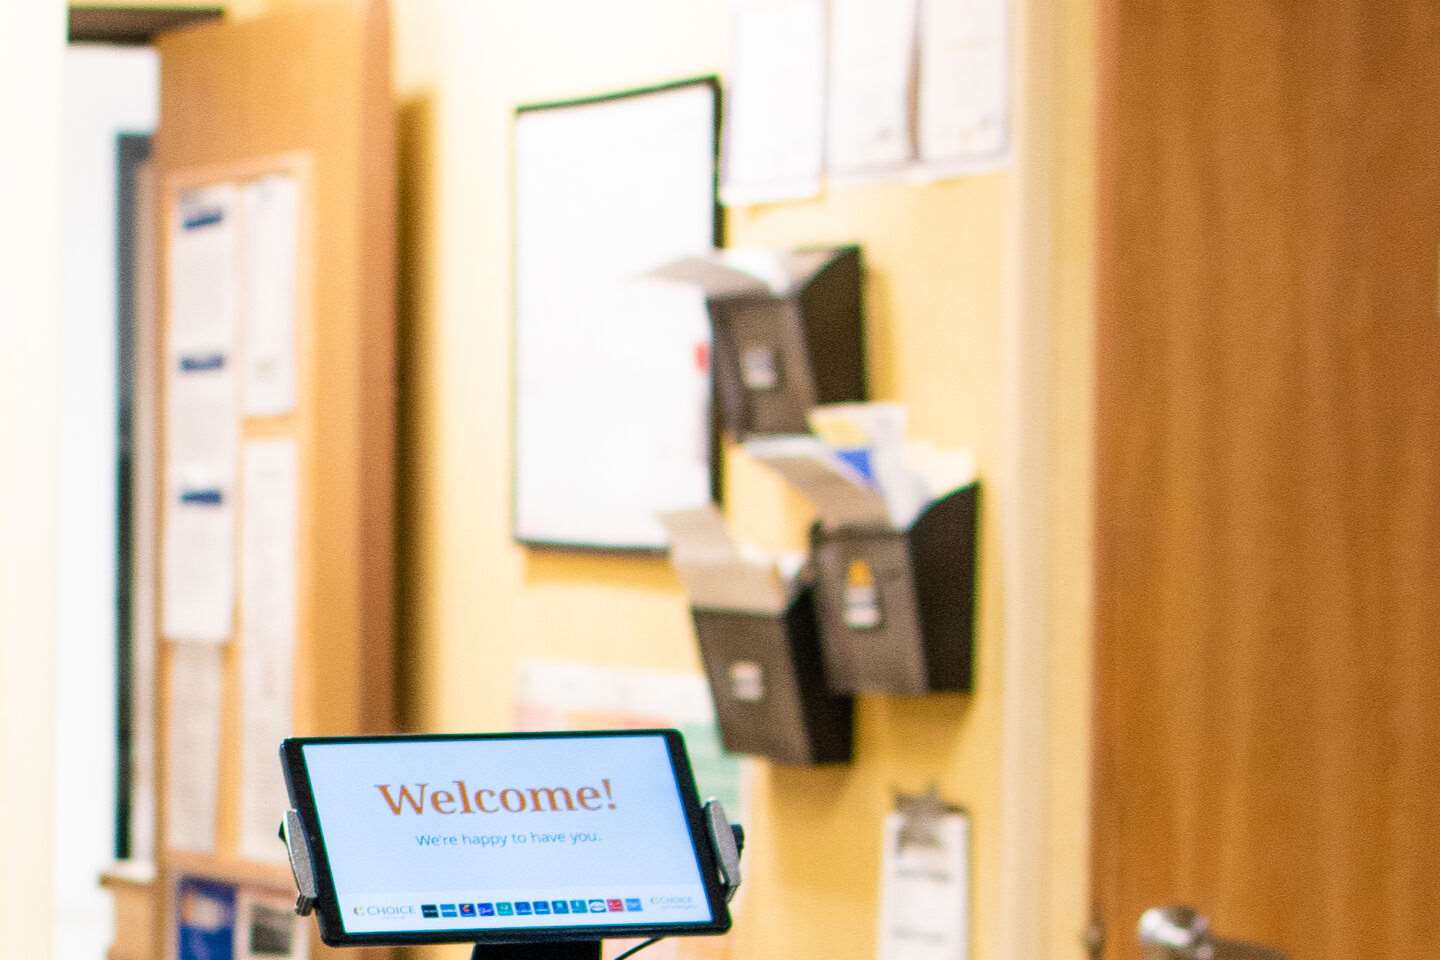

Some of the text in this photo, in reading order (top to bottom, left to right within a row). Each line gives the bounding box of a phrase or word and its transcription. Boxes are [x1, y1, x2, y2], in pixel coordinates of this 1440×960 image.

[373, 778, 617, 816] Welcome!
[415, 831, 602, 848] We're happy to have you.
[366, 904, 417, 916] CHOICE
